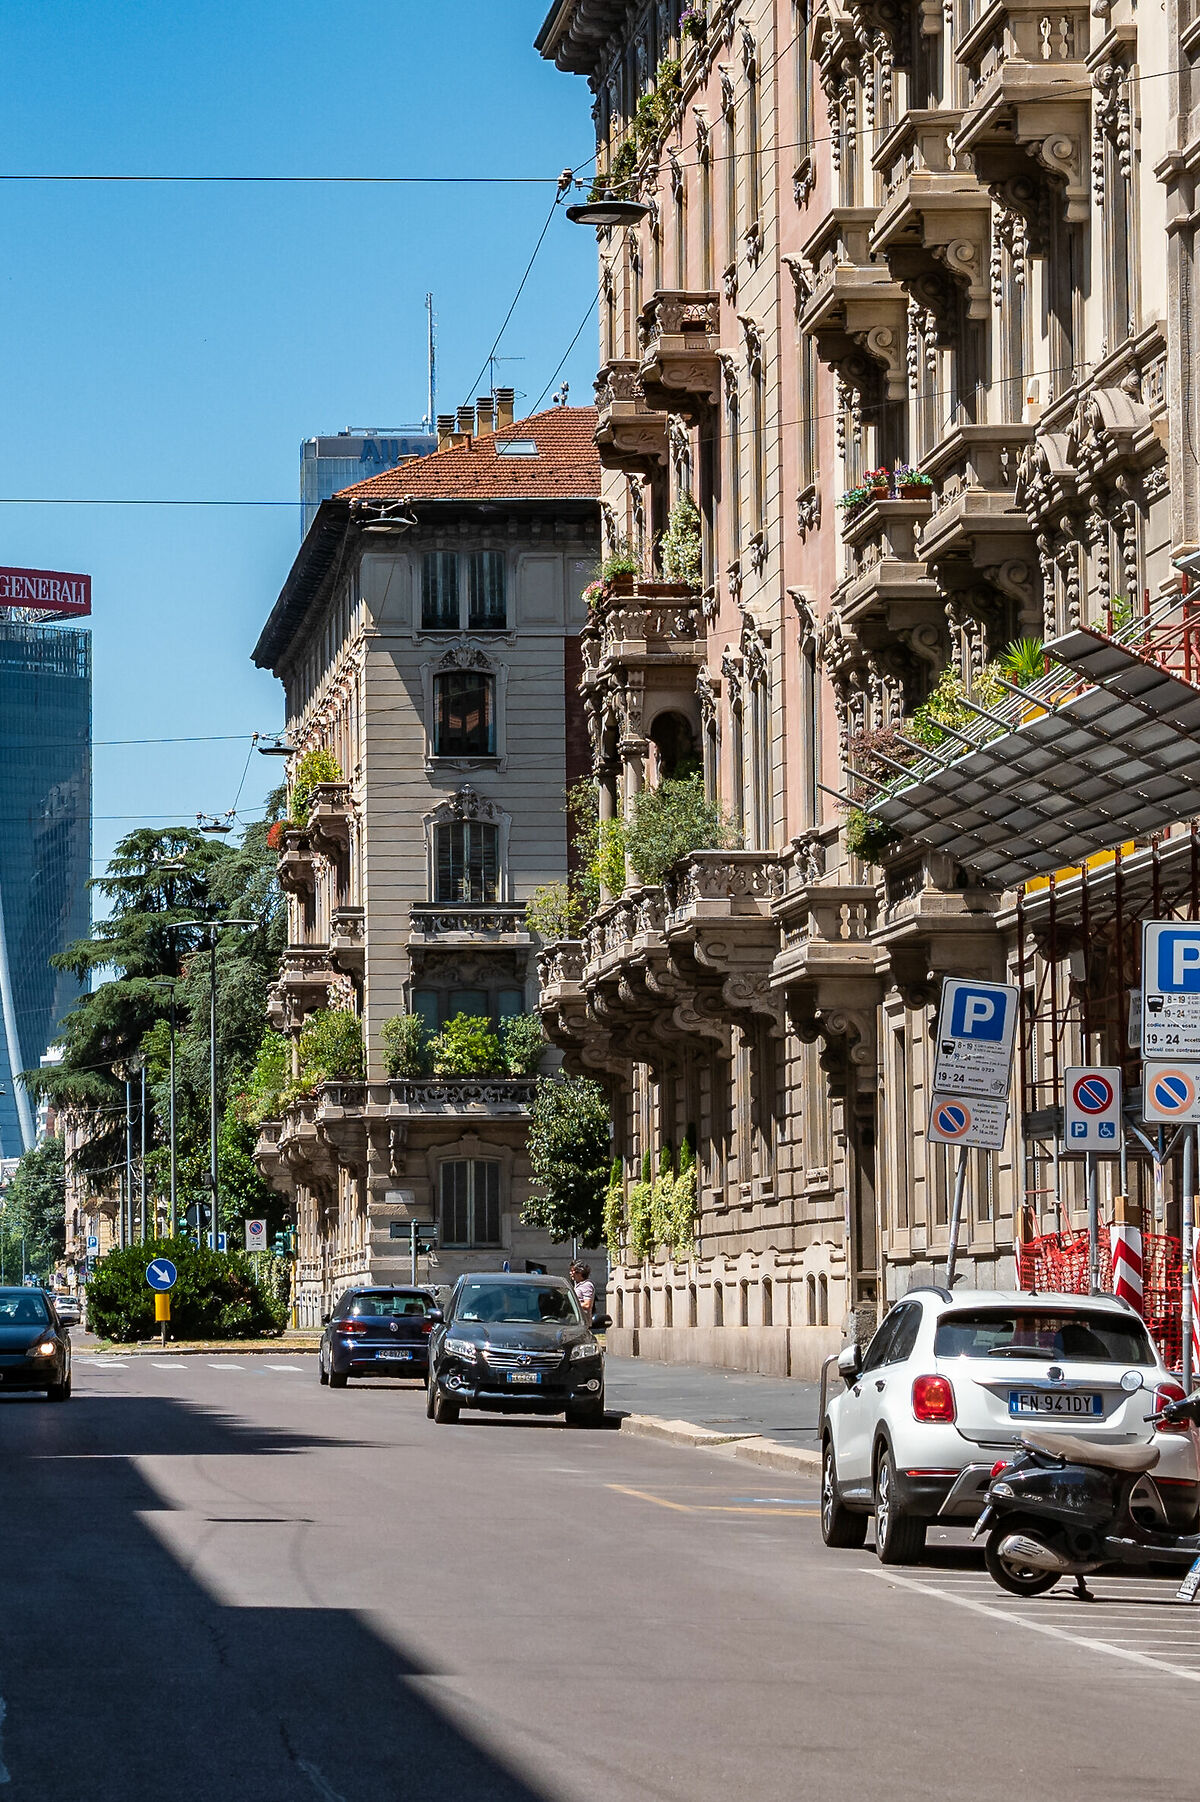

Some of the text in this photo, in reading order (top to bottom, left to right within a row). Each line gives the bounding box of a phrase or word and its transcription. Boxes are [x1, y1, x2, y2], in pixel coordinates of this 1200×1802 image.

[1173, 940, 1200, 984] P
[963, 995, 994, 1033] P
[1075, 1123, 1085, 1136] P
